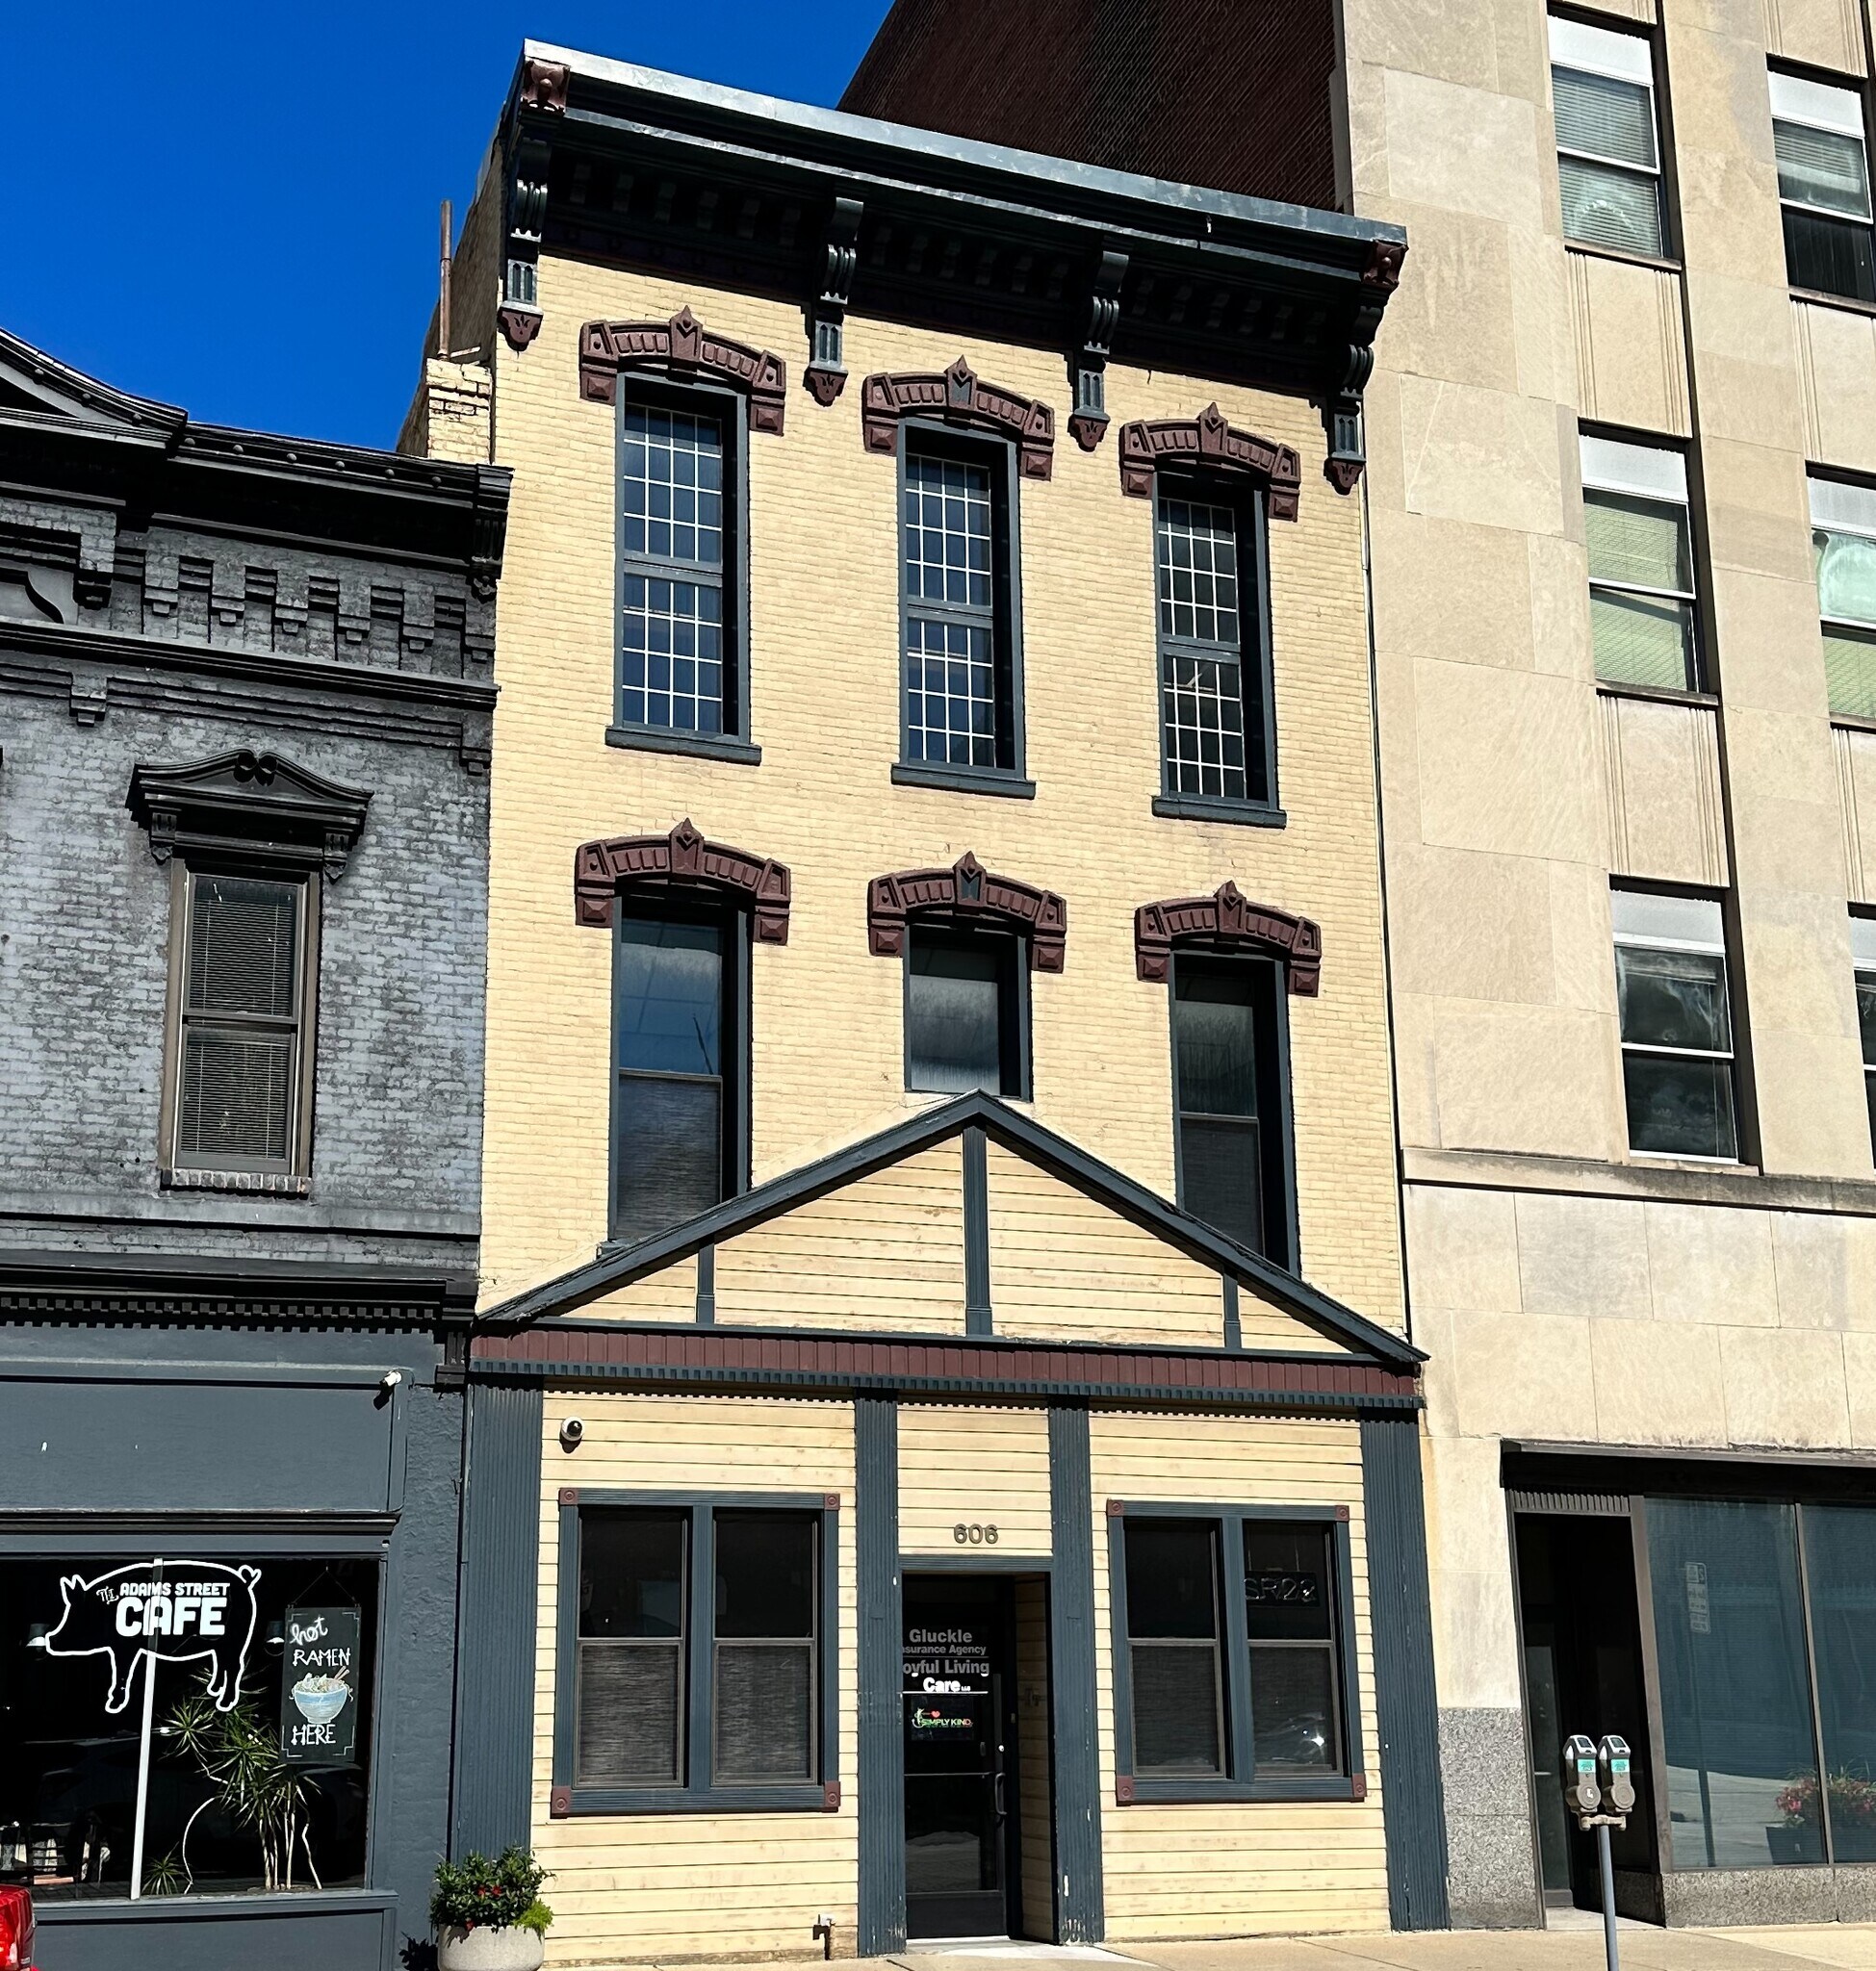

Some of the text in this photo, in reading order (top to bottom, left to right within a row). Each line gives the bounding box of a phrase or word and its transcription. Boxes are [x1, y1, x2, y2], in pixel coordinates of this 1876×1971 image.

[953, 1523, 999, 1544] 606
[119, 1582, 171, 1597] ADAMS
[174, 1582, 231, 1597] STREET
[116, 1596, 228, 1637] CAFE
[289, 1616, 329, 1646] hot
[909, 1628, 973, 1644] Gluckle
[292, 1648, 351, 1667] RAMEN
[948, 1644, 987, 1656] Agency
[902, 1659, 989, 1677] oyful Living
[922, 1677, 961, 1692] Care
[291, 1724, 337, 1746] HERE
